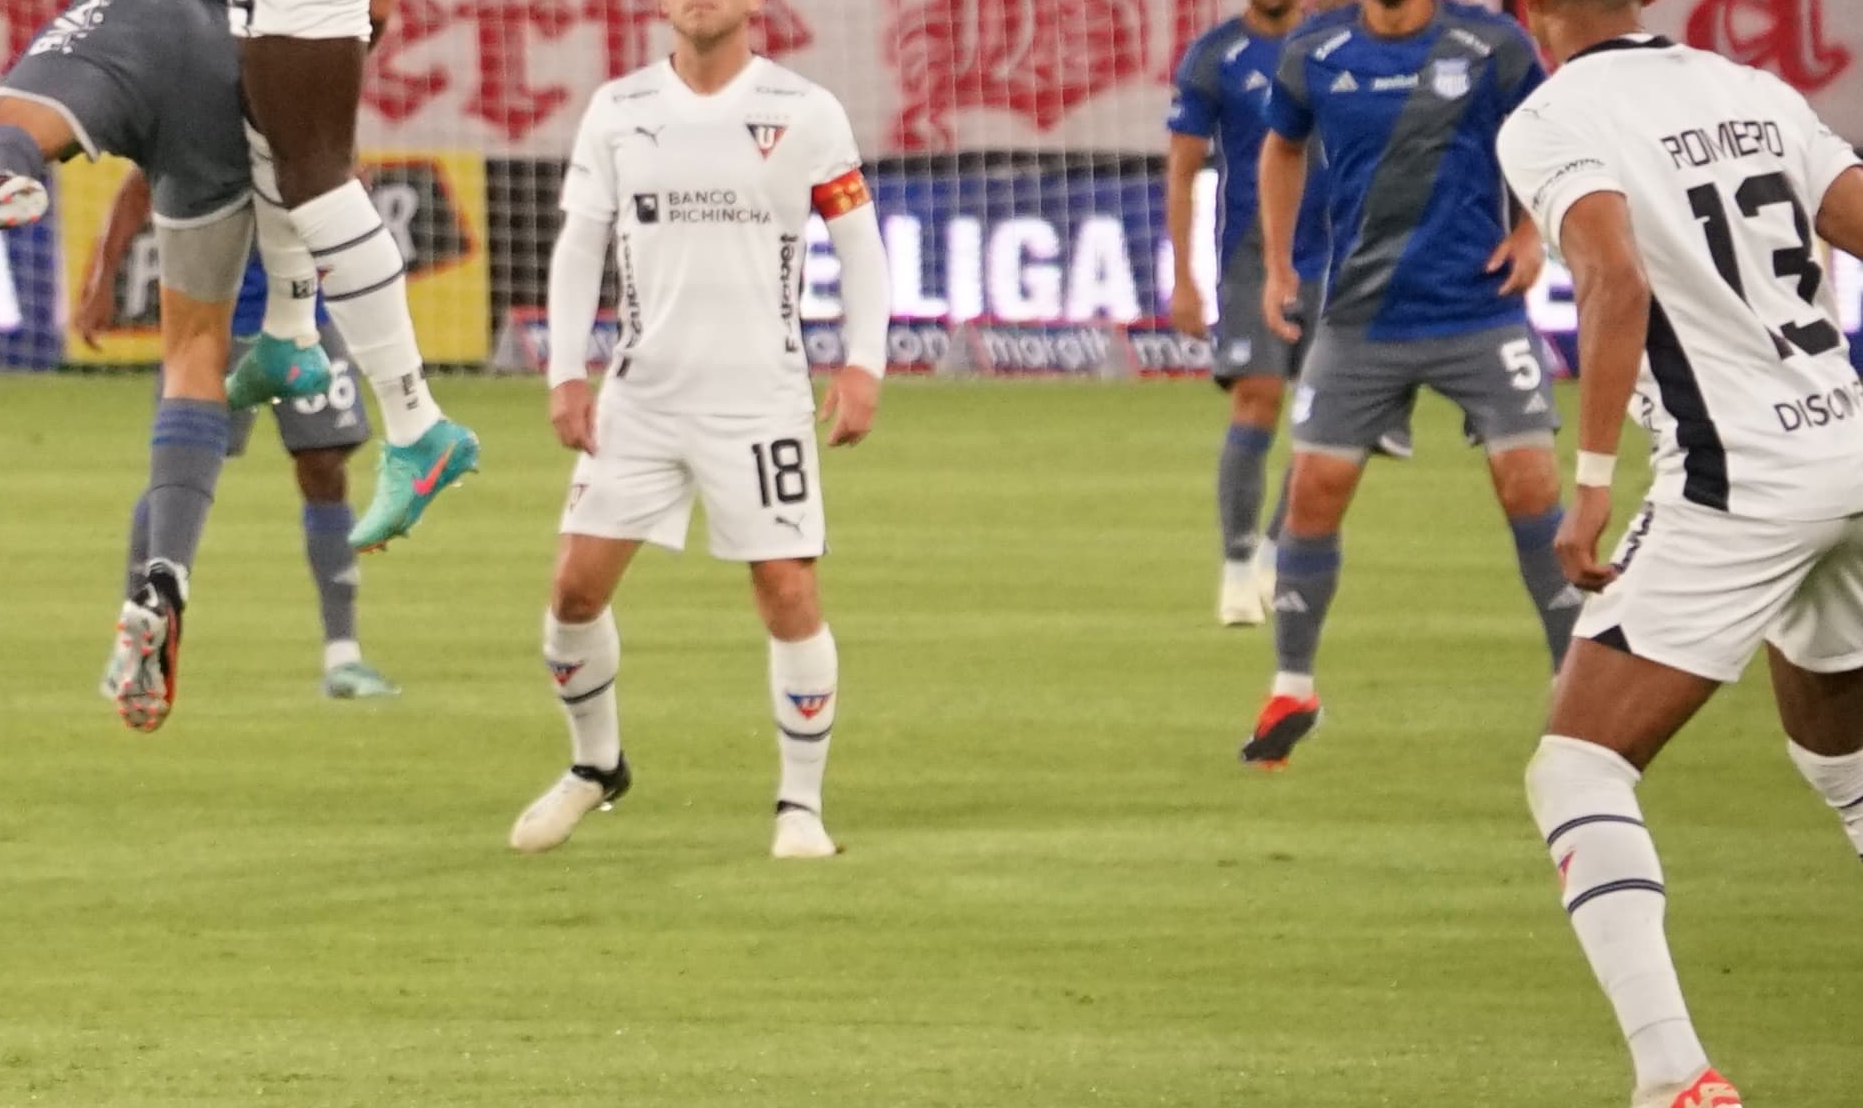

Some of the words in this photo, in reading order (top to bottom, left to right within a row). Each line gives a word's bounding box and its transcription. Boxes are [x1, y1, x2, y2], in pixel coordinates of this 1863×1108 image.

[1661, 120, 1785, 170] ROMERO
[669, 191, 738, 206] BANCO
[669, 209, 773, 225] PICHINCHA
[884, 214, 1139, 326] LIGA
[1686, 171, 1842, 361] 13
[1500, 338, 1542, 390] 5
[751, 437, 809, 508] 18
